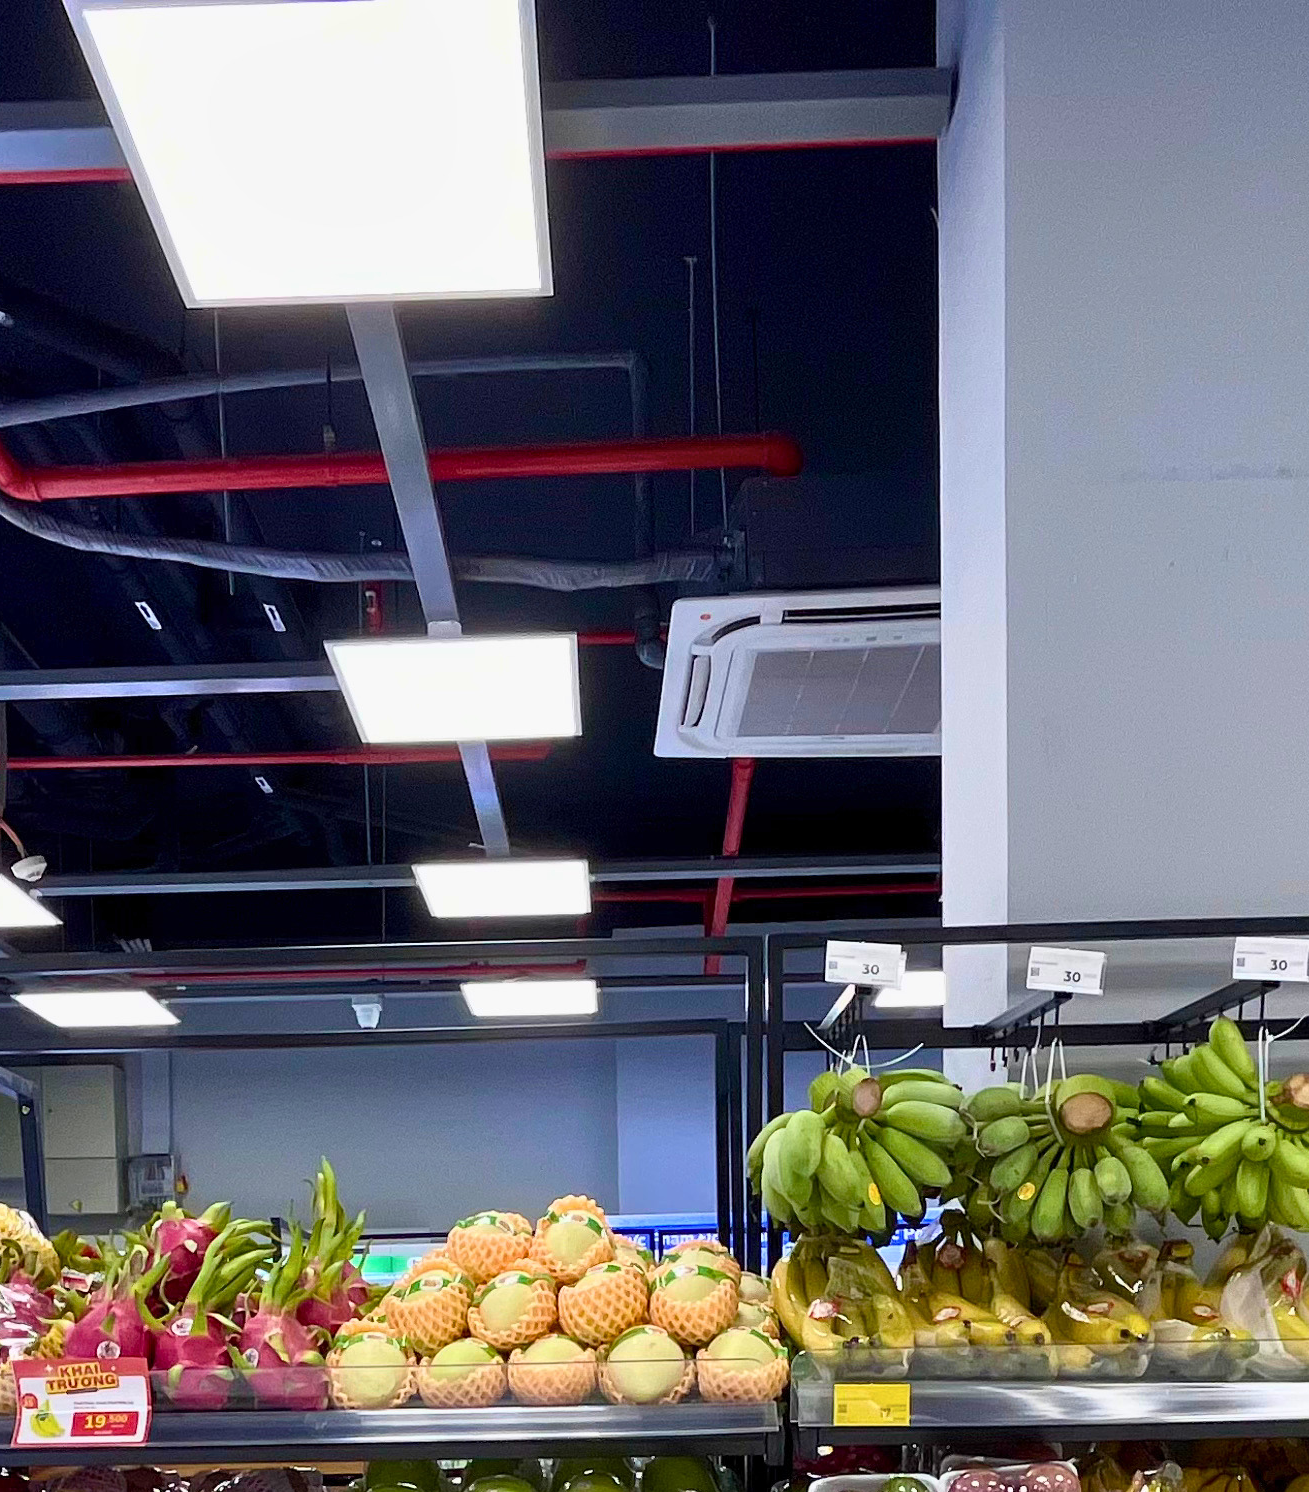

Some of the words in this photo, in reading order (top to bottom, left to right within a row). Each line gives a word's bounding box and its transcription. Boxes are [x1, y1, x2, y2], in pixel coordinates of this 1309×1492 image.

[862, 964, 880, 975] 30
[1270, 959, 1288, 971] 30
[1063, 971, 1081, 983] 30
[59, 1363, 99, 1378] KHAI
